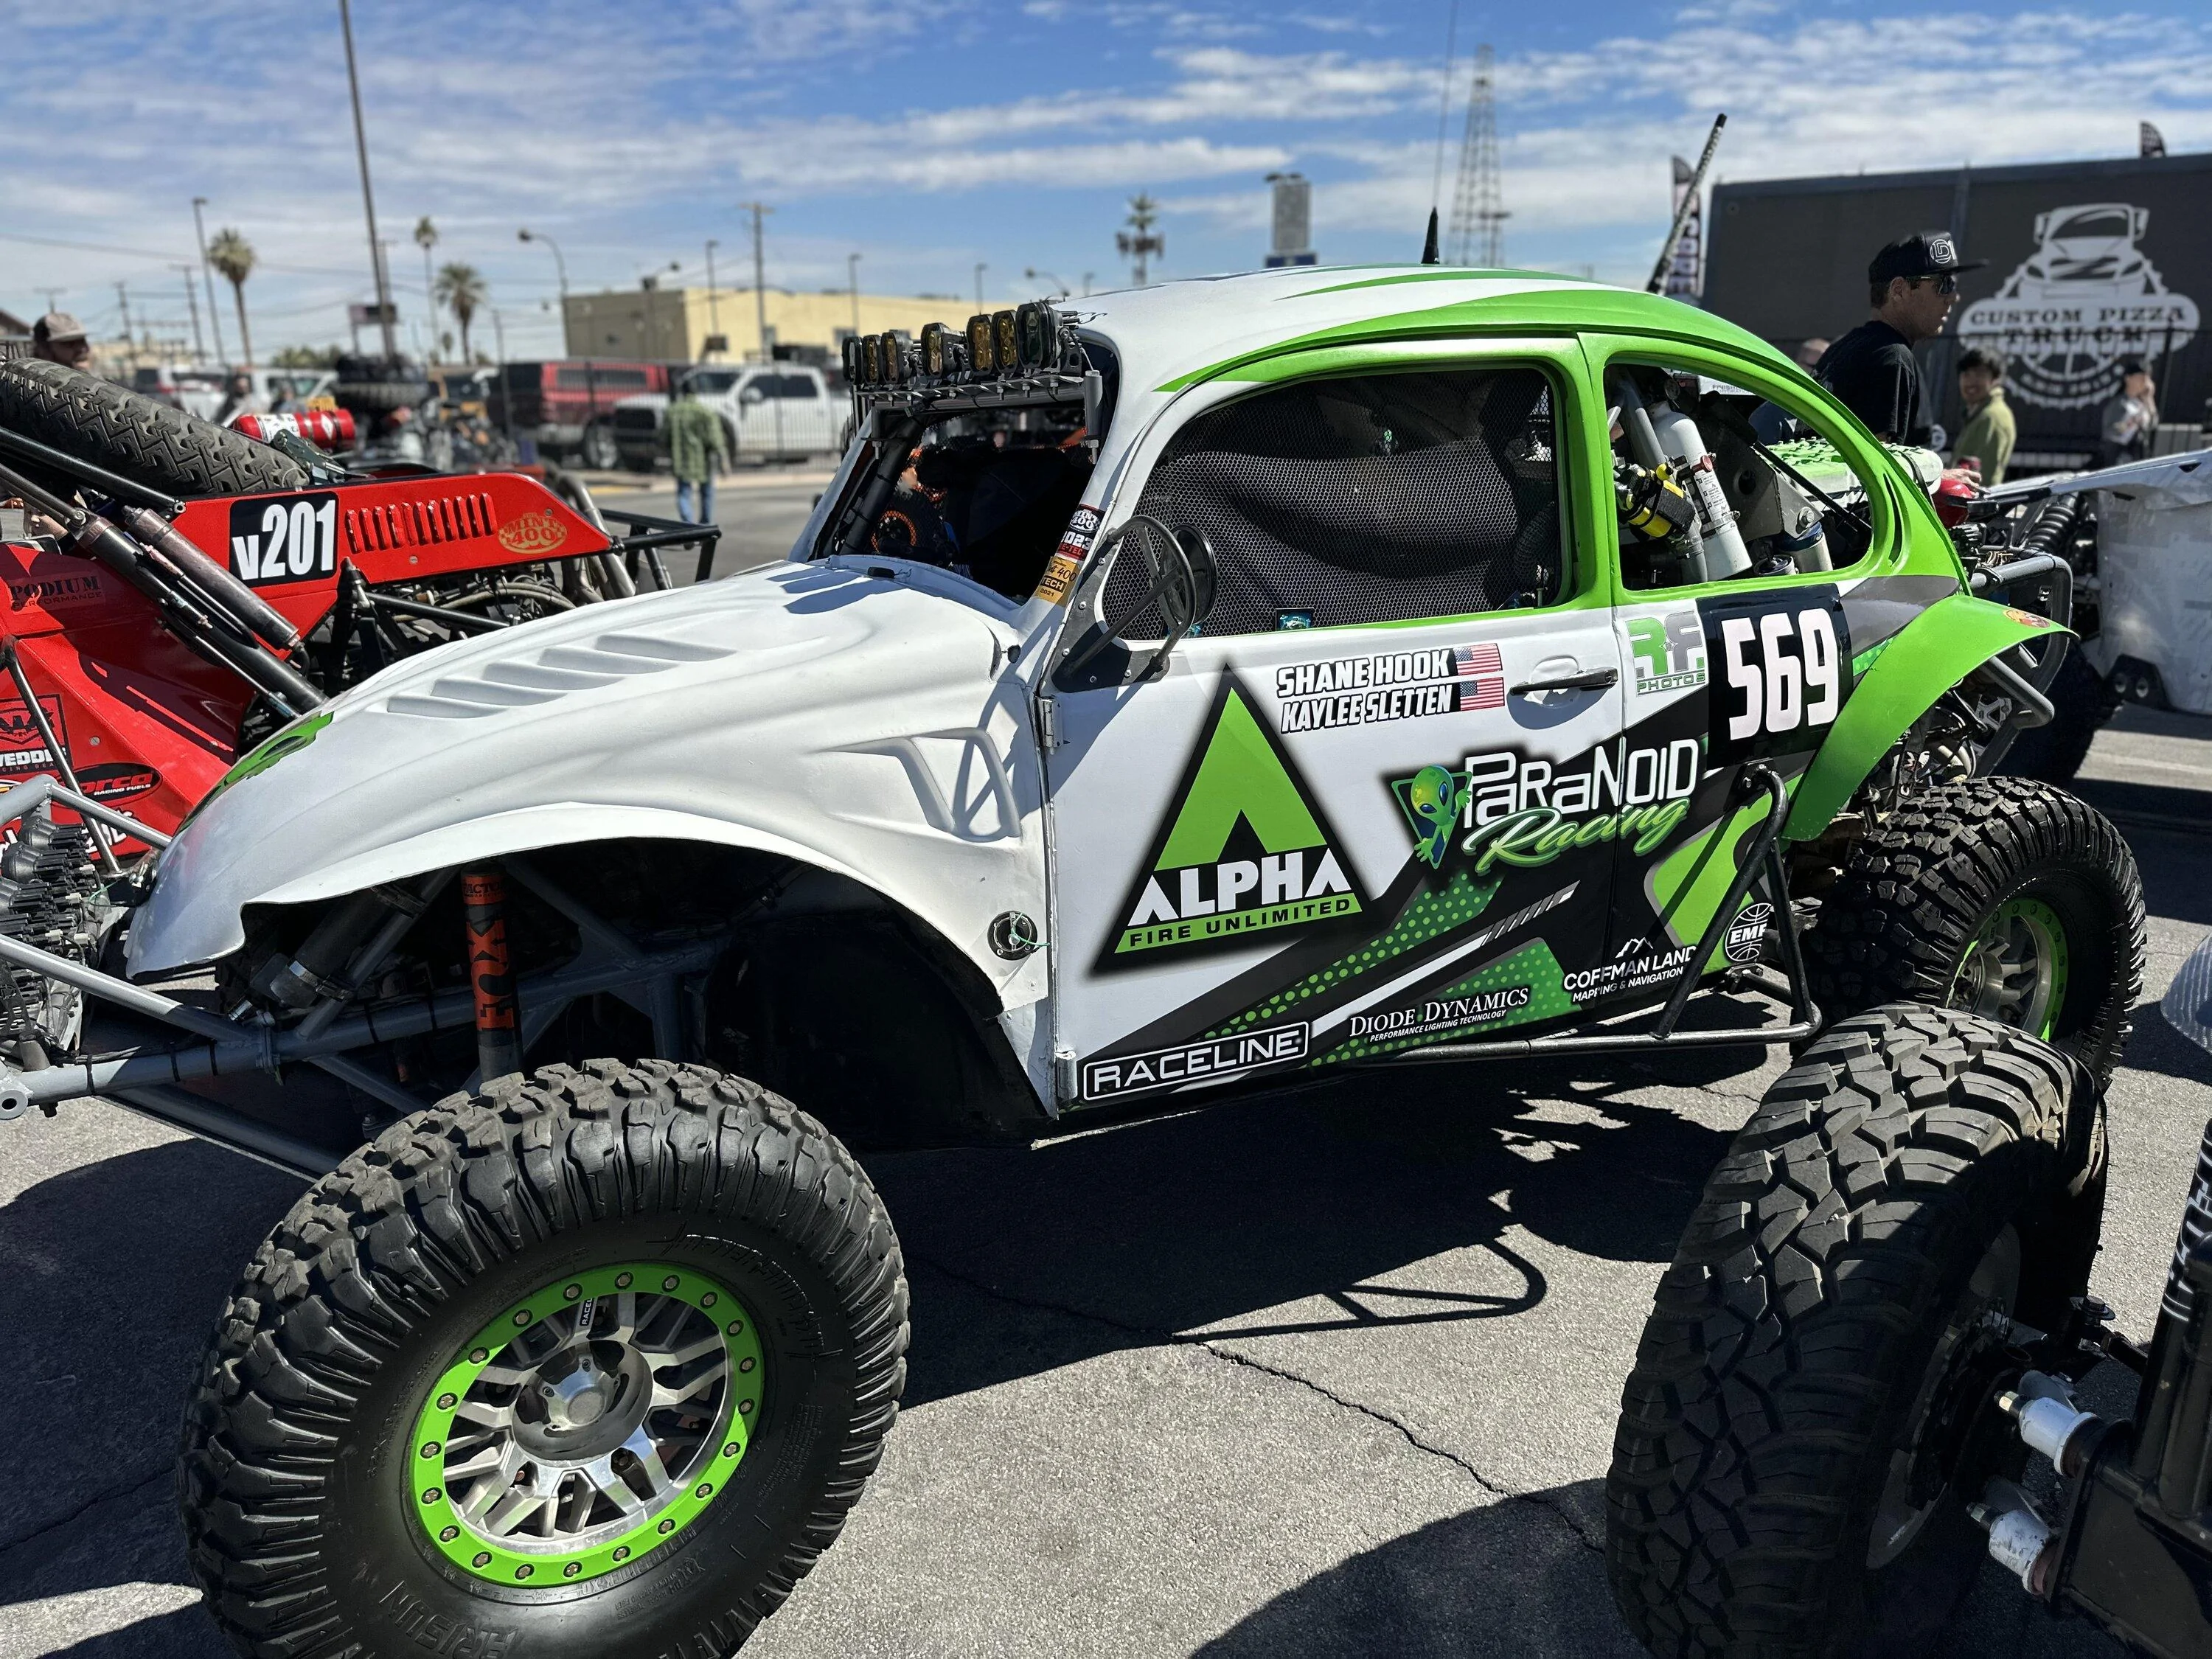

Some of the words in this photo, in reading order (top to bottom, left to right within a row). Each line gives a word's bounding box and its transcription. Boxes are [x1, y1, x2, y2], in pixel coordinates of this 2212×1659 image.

[1970, 307, 2083, 326] CUSTOM
[2098, 305, 2185, 322] PIZZA
[1074, 510, 1099, 524] INT
[232, 499, 337, 581] v201
[512, 527, 556, 544] 400
[10, 576, 100, 601] PODIUM
[1041, 577, 1064, 591] TECH
[1057, 566, 1077, 582] 400
[11, 591, 104, 609] PERFORMANCE
[1040, 588, 1054, 597] 2021
[1277, 658, 1371, 698] SHANE
[1374, 649, 1450, 685] HOOK
[1636, 672, 1705, 693] PHOTOS
[1721, 608, 1839, 741] 569
[1281, 692, 1363, 733] KAYLEE
[1363, 684, 1453, 723] SLETTEN
[0, 747, 66, 767] EDDL
[94, 787, 125, 796] RACING
[125, 783, 152, 793] FUELS
[1461, 796, 1690, 875] Racing
[1128, 849, 1352, 927] ALPHA
[1130, 921, 1193, 947] FIRE
[1205, 898, 1352, 933] UNLIMITED
[1563, 956, 1650, 991] COFFMAN
[1652, 945, 1697, 971] LAND
[1572, 982, 1618, 1003] MAPPING
[1619, 979, 1627, 990] &
[1627, 966, 1684, 988] NAVIGATION
[1369, 1024, 1424, 1043] PERFORMANCE
[1424, 1019, 1458, 1032] LIGHTING
[1459, 1009, 1507, 1026] TECHNOLOGY
[1093, 1028, 1301, 1094] RACELINE
